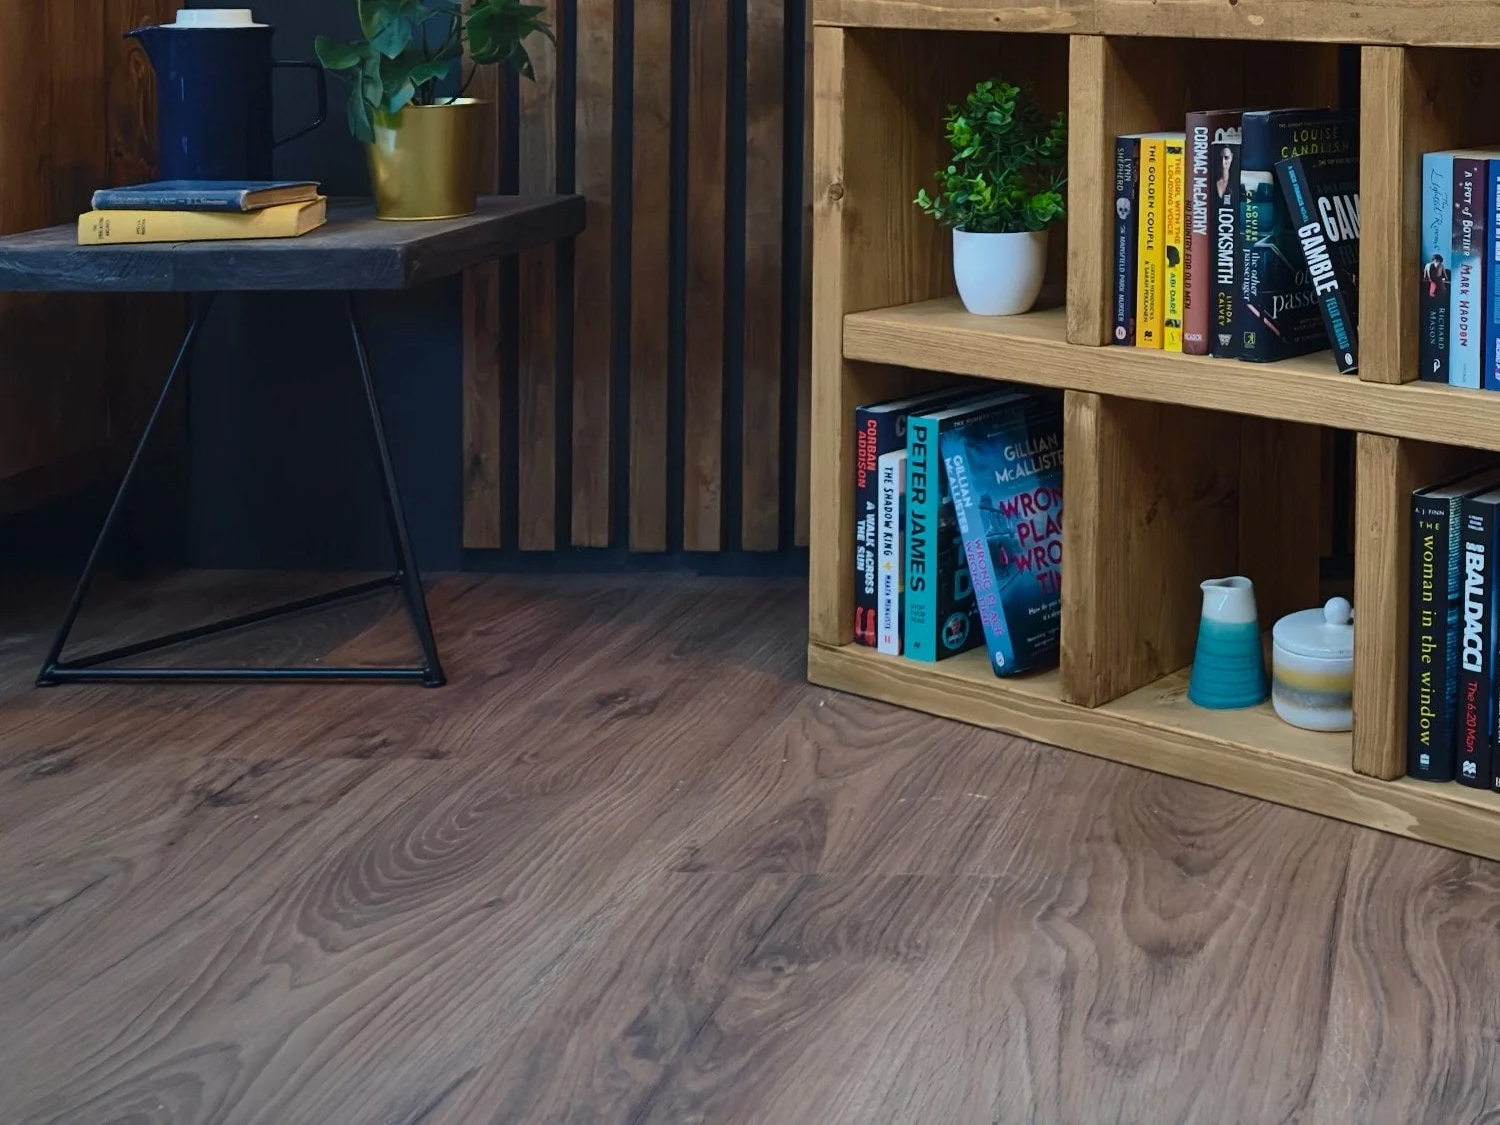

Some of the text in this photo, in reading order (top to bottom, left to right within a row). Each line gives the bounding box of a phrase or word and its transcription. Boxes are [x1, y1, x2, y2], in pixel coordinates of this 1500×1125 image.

[1116, 148, 1124, 191] SHEPHERD
[1192, 126, 1208, 235] CORMAC McCARTHY
[1463, 182, 1472, 203] SPOT
[1185, 213, 1193, 251] COUNTRY
[1218, 207, 1234, 284] LOCKSMITH
[1462, 219, 1474, 256] BOTHER
[1169, 273, 1177, 286] ABI
[1242, 249, 1251, 301] passenger
[1251, 252, 1260, 295] the other
[1297, 221, 1339, 296] GAMBLE
[1460, 264, 1473, 296] MARK
[1325, 297, 1340, 319] FELIX
[1429, 310, 1437, 345] MASON
[1437, 307, 1446, 349] RICHARD
[857, 430, 867, 488] ADDISON
[866, 419, 877, 471] CORBAN
[1003, 433, 1058, 462] GILLIAN
[952, 455, 973, 508] GILLIAN
[883, 467, 893, 556] THE SHADOW KING
[910, 424, 927, 592] PETER JAMES
[1419, 521, 1440, 531] THE
[856, 520, 866, 571] THE SUN
[864, 501, 876, 594] A WALK ACROSS
[974, 538, 1003, 635] WRONG PLACE
[1463, 552, 1485, 672] BALDACCI
[1420, 535, 1438, 746] woman in the window
[1467, 681, 1477, 699] The
[1466, 728, 1477, 752] Man
